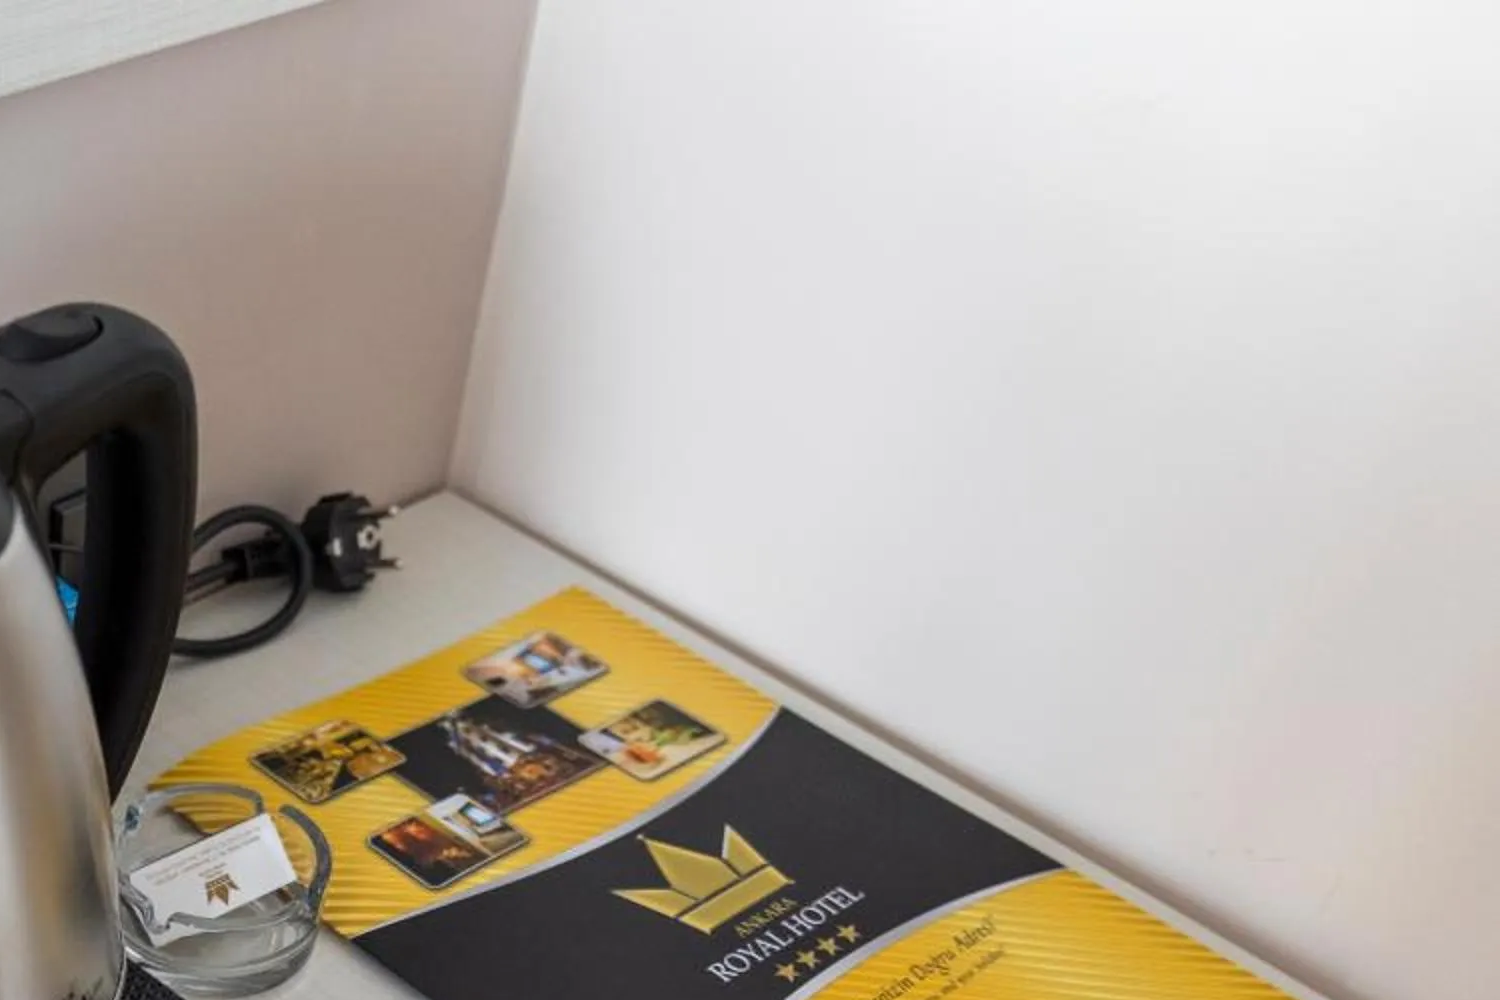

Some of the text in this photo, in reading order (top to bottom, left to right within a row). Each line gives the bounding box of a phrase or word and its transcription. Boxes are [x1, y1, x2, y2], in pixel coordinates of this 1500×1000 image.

[706, 886, 866, 983] ROYAL HOTEL
[734, 897, 798, 938] ANKARA
